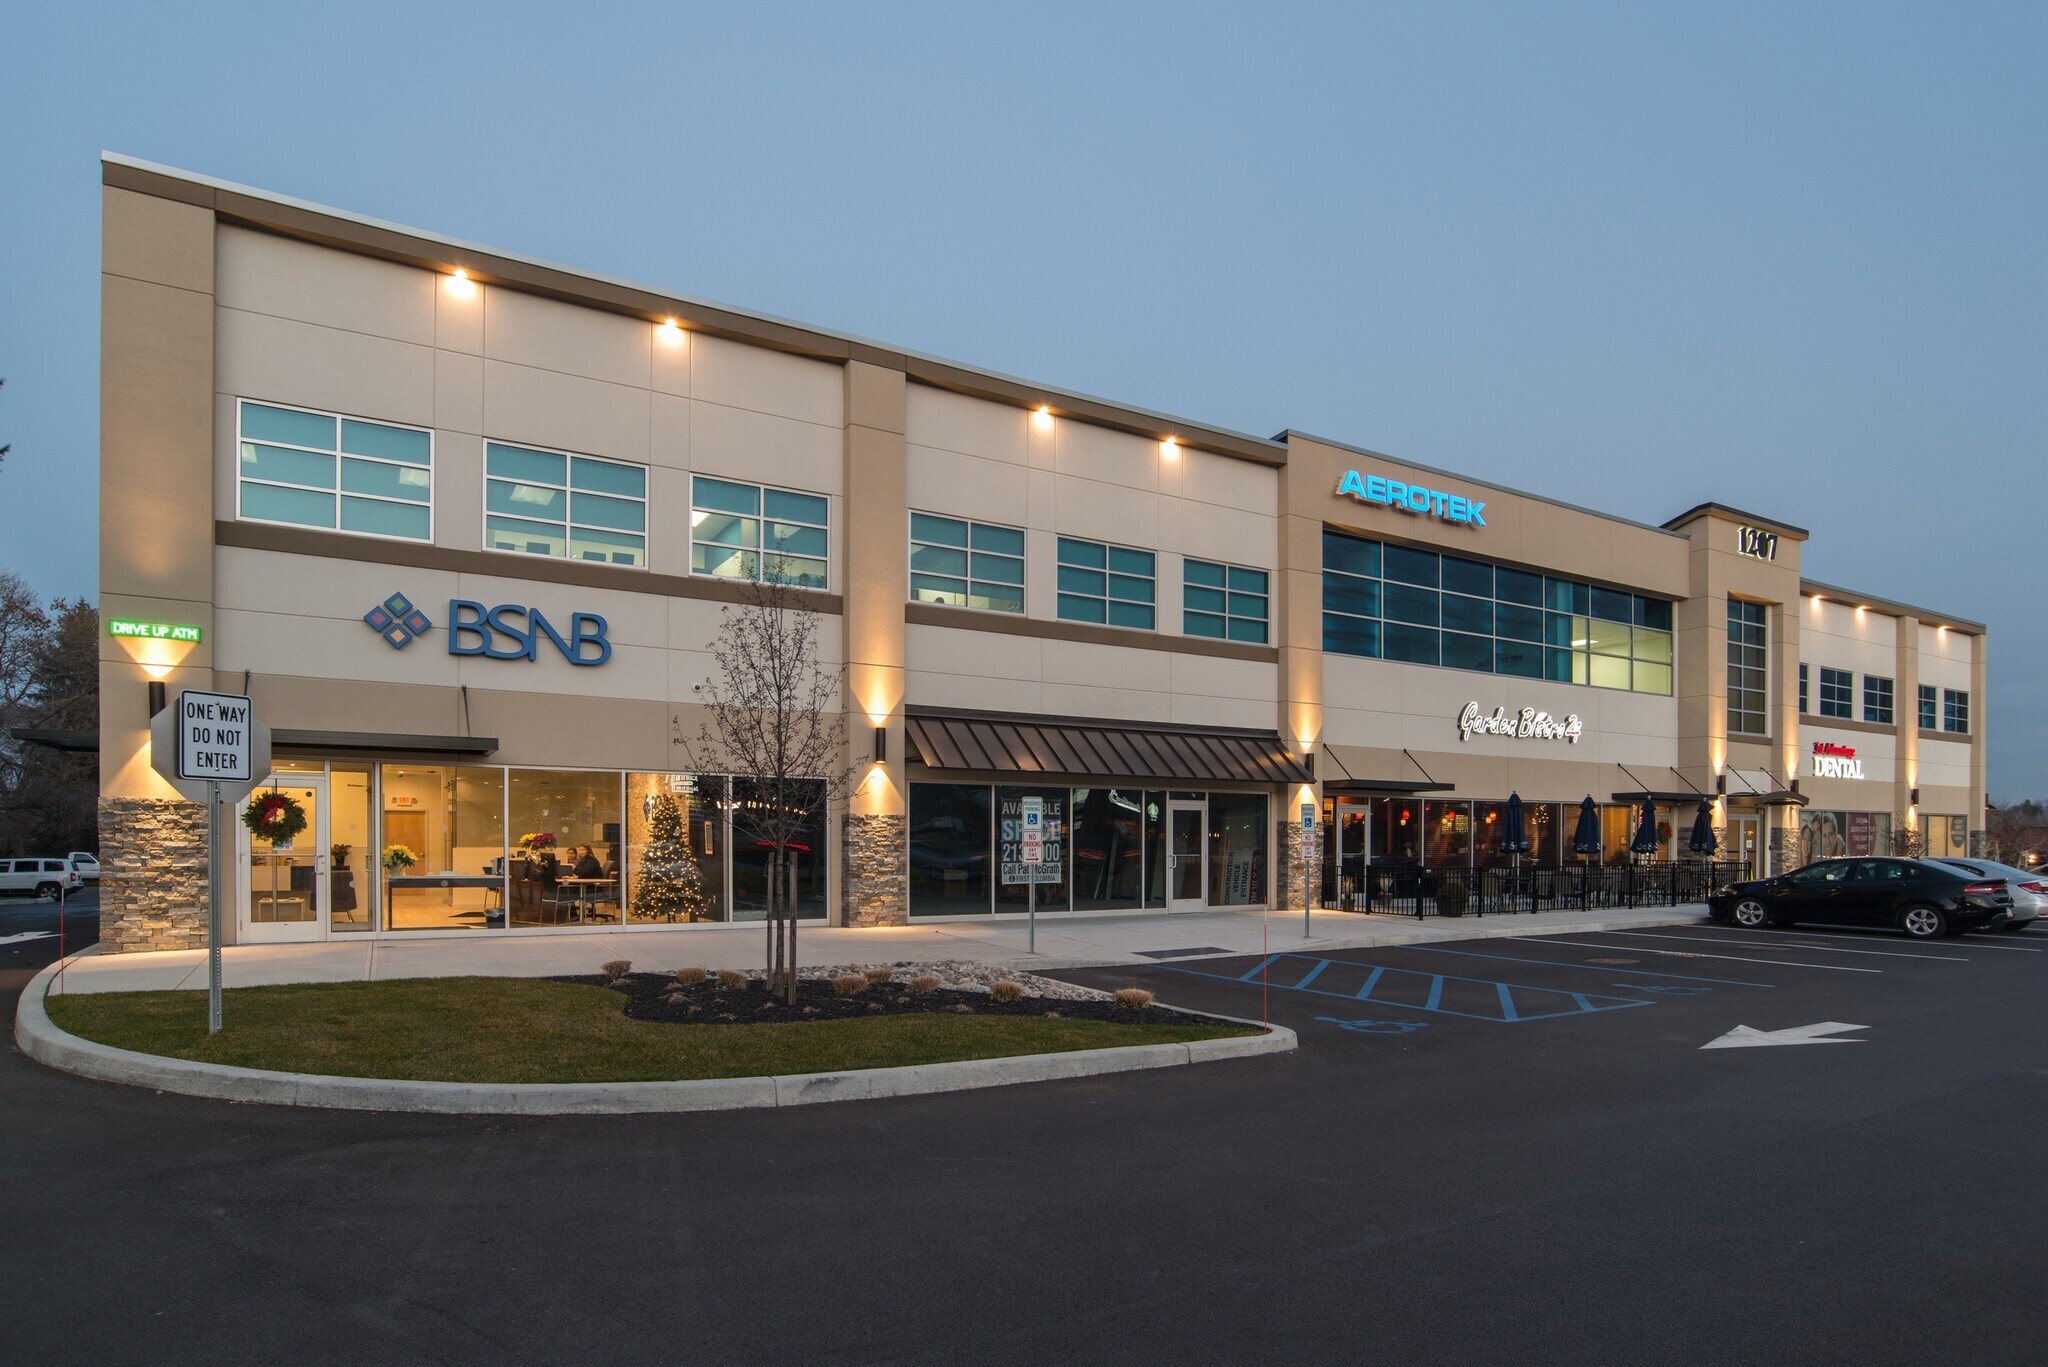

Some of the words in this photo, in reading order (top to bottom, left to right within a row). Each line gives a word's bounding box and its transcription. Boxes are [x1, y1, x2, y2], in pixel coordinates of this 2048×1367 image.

[1336, 469, 1487, 527] AEROTEK
[1737, 526, 1778, 562] 1207
[113, 622, 149, 636] DRIVE
[152, 626, 169, 638] UP
[172, 627, 198, 640] ATM
[448, 598, 612, 666] BSNB
[186, 702, 214, 720] ONE
[218, 704, 246, 723] WAY
[1459, 701, 1517, 742] Garden
[1518, 707, 1566, 740] Bistro
[192, 727, 210, 744] DO
[217, 729, 241, 746] NOT
[196, 752, 237, 770] ENTER
[1813, 756, 1864, 780] DENTAL
[1003, 864, 1016, 875] Call
[1018, 864, 1030, 875] Pat
[1224, 852, 1234, 905] CONSTRUCTION
[1233, 864, 1241, 893] VEHICLE
[1240, 861, 1250, 897] ENTRANCE
